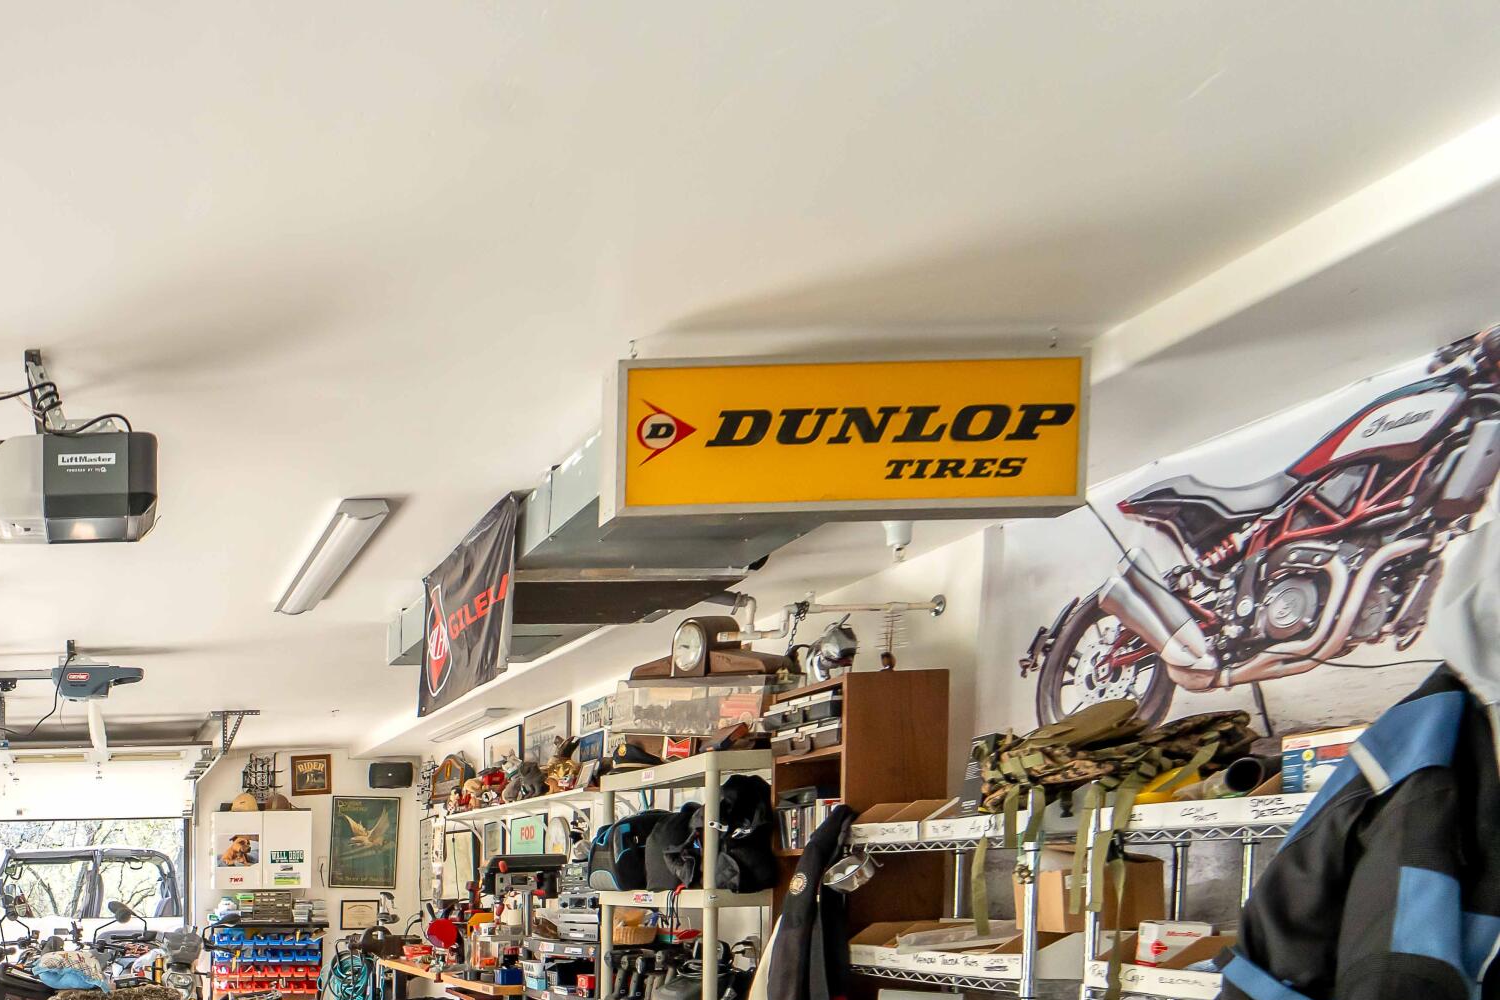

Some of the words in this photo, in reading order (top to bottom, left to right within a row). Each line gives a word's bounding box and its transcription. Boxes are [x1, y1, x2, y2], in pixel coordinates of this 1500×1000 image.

[704, 403, 1077, 448] DUNLOP
[1361, 409, 1436, 438] Indian
[61, 455, 113, 464] LiftMaster
[884, 457, 1028, 480] TIRES
[297, 761, 325, 773] RIDER
[520, 825, 535, 841] FOD
